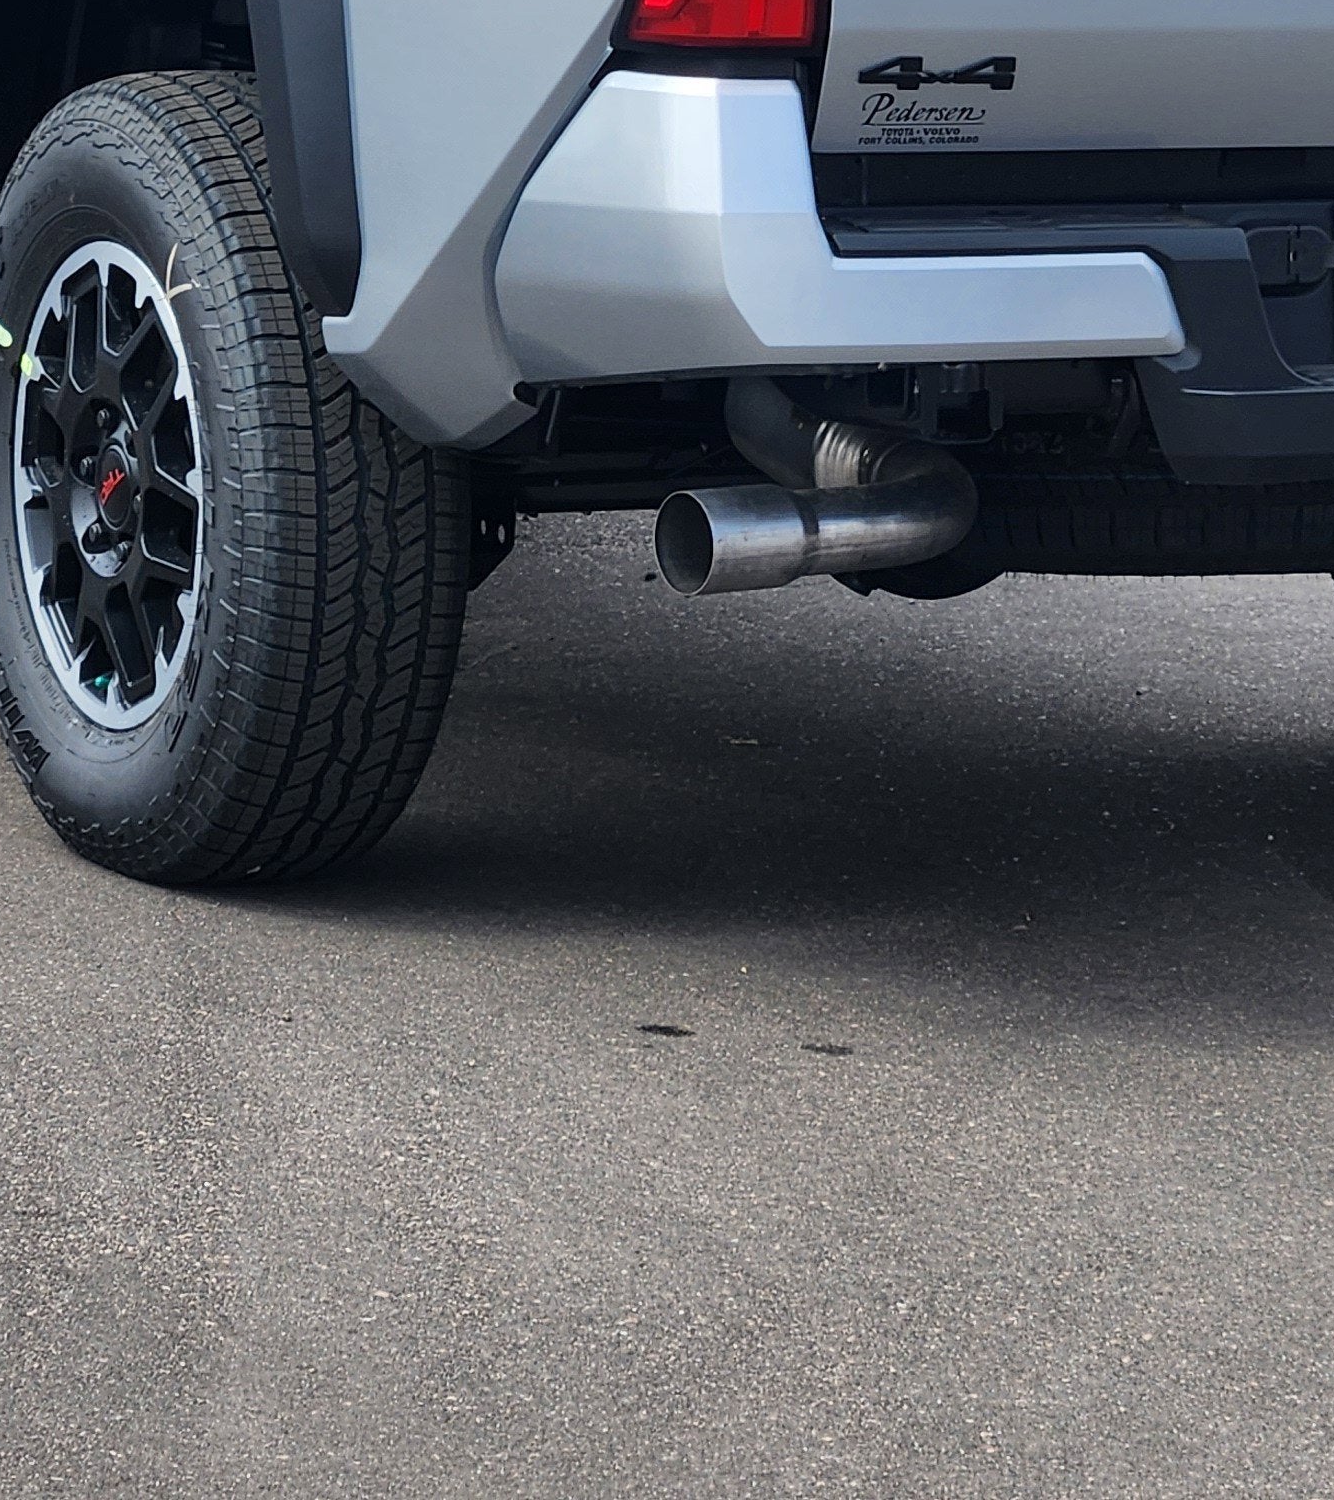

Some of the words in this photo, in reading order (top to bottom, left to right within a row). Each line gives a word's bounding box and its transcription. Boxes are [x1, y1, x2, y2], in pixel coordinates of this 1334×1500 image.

[861, 92, 986, 126] Pedersen
[881, 128, 915, 136] TOYOTA
[923, 127, 961, 136] VOLVO
[858, 137, 883, 145] FORT
